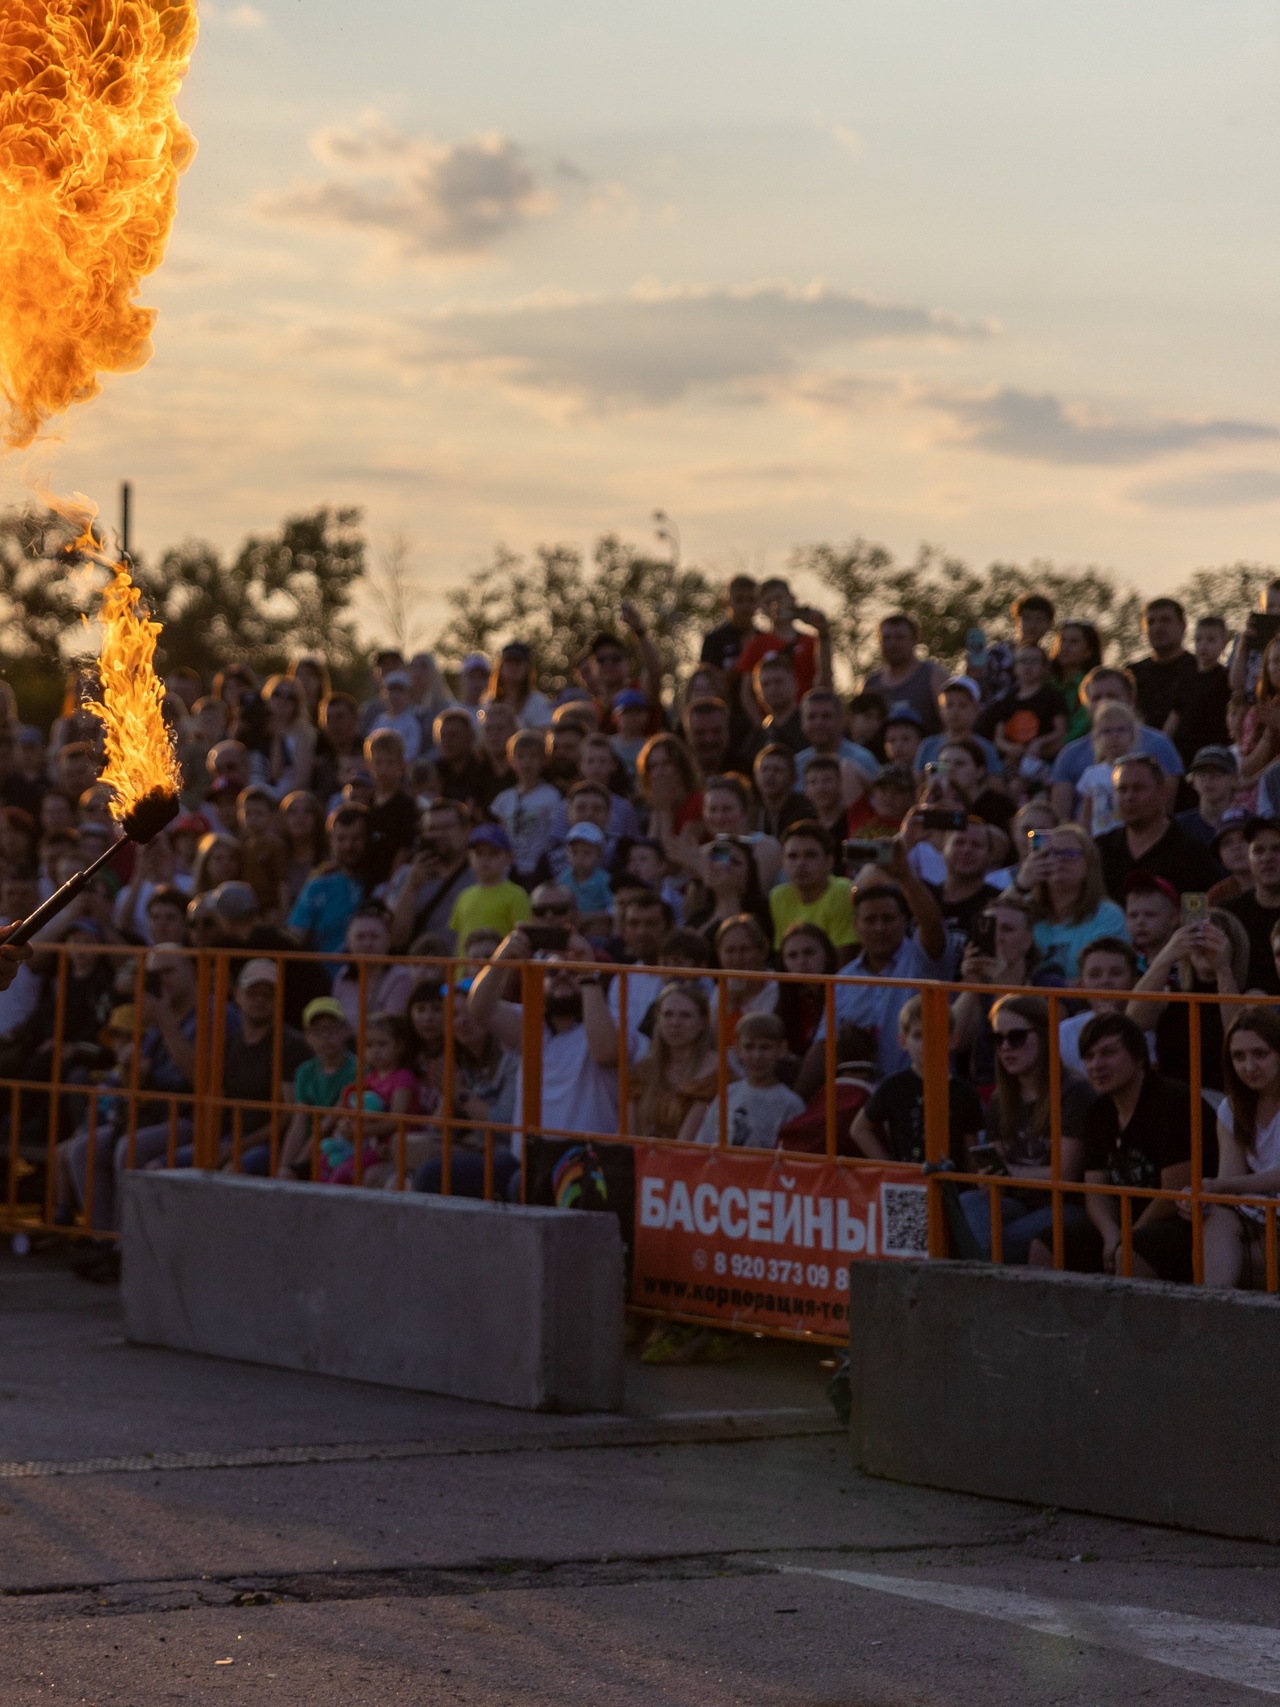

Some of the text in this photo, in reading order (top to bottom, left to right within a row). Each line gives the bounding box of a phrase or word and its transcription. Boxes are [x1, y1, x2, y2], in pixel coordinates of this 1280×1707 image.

[640, 1175, 876, 1255] БАССЕЙНЫ
[713, 1251, 850, 1291] 8 920 373 09 8
[643, 1276, 850, 1321] www.корпорация-те
